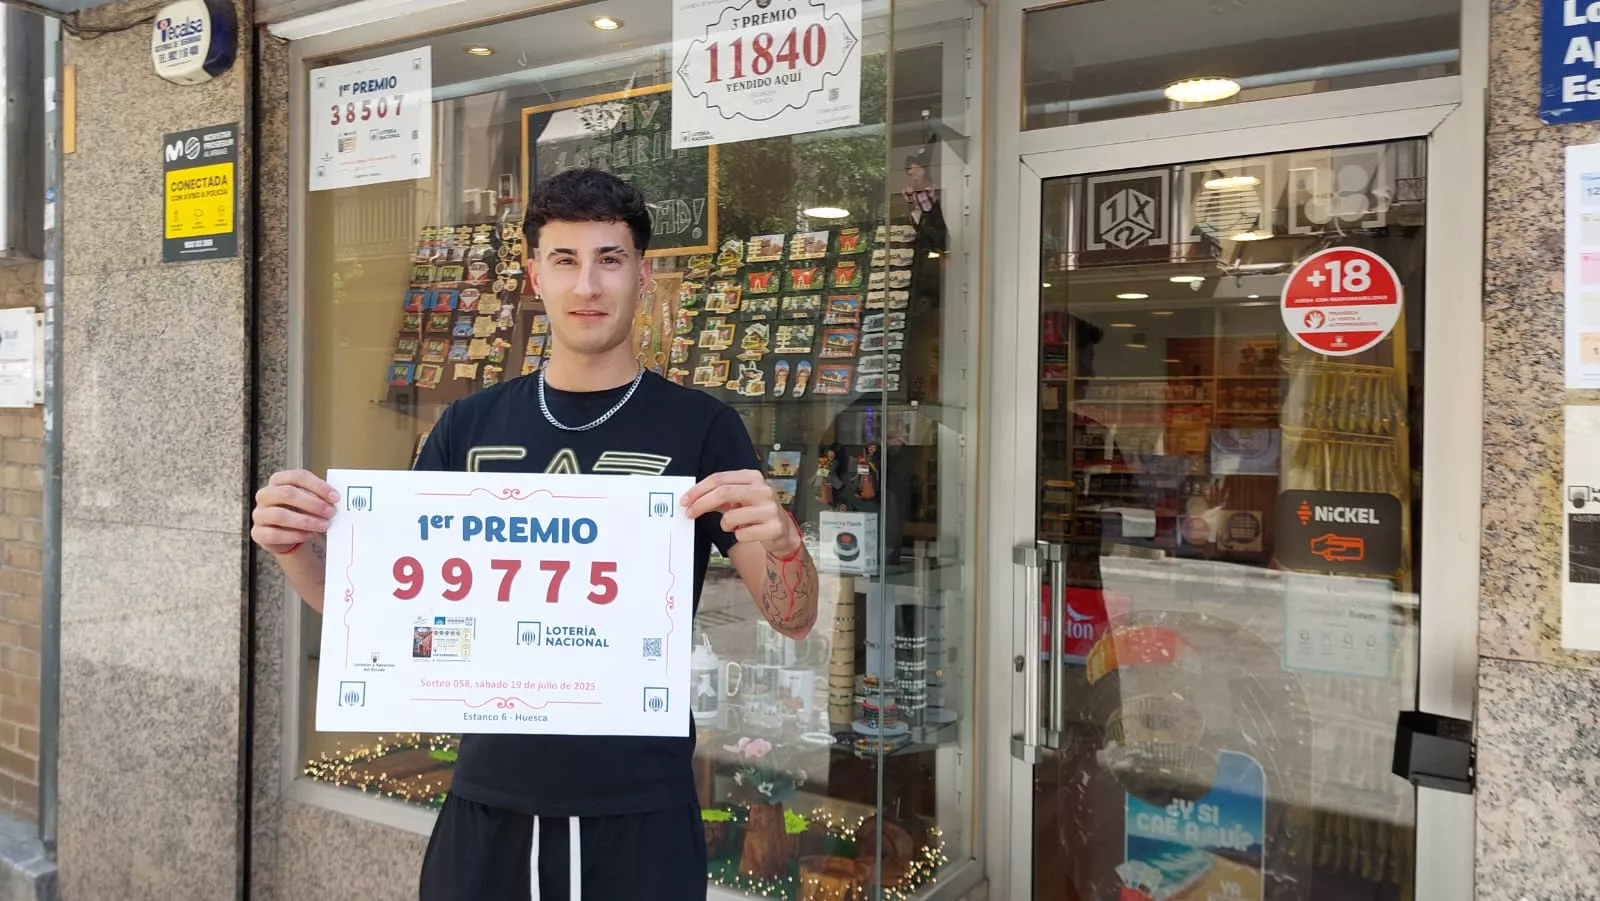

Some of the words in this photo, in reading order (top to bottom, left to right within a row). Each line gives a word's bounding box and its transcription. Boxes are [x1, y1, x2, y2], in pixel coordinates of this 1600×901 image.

[742, 8, 797, 28] PREMIO
[157, 16, 203, 42] Tecalsa
[705, 23, 827, 84] 11840
[339, 84, 351, 97] 1er
[352, 76, 397, 95] PREMIO
[726, 78, 772, 92] VENDIDO
[774, 69, 803, 85] AQUÍ
[330, 94, 404, 126] 38507
[171, 175, 228, 192] CONECTADA
[1306, 258, 1372, 293] +18
[1314, 506, 1380, 525] NiCKEL
[417, 515, 454, 540] 1er
[462, 515, 598, 544] PREMIO
[392, 556, 619, 605] 99775
[546, 625, 597, 636] LOTERÍA
[546, 638, 610, 648] NACIONAL
[421, 679, 451, 688] Sorteo
[453, 680, 473, 690] 058,
[475, 680, 508, 690] sábado
[511, 681, 522, 690] 19
[524, 682, 536, 691] de
[537, 681, 558, 692] julio
[560, 682, 572, 692] de
[574, 682, 597, 692] 2025
[463, 712, 499, 722] Estanco
[501, 713, 507, 722] 6
[515, 714, 548, 723] Huesca
[1137, 812, 1178, 836] CAE
[1198, 804, 1219, 825] SI
